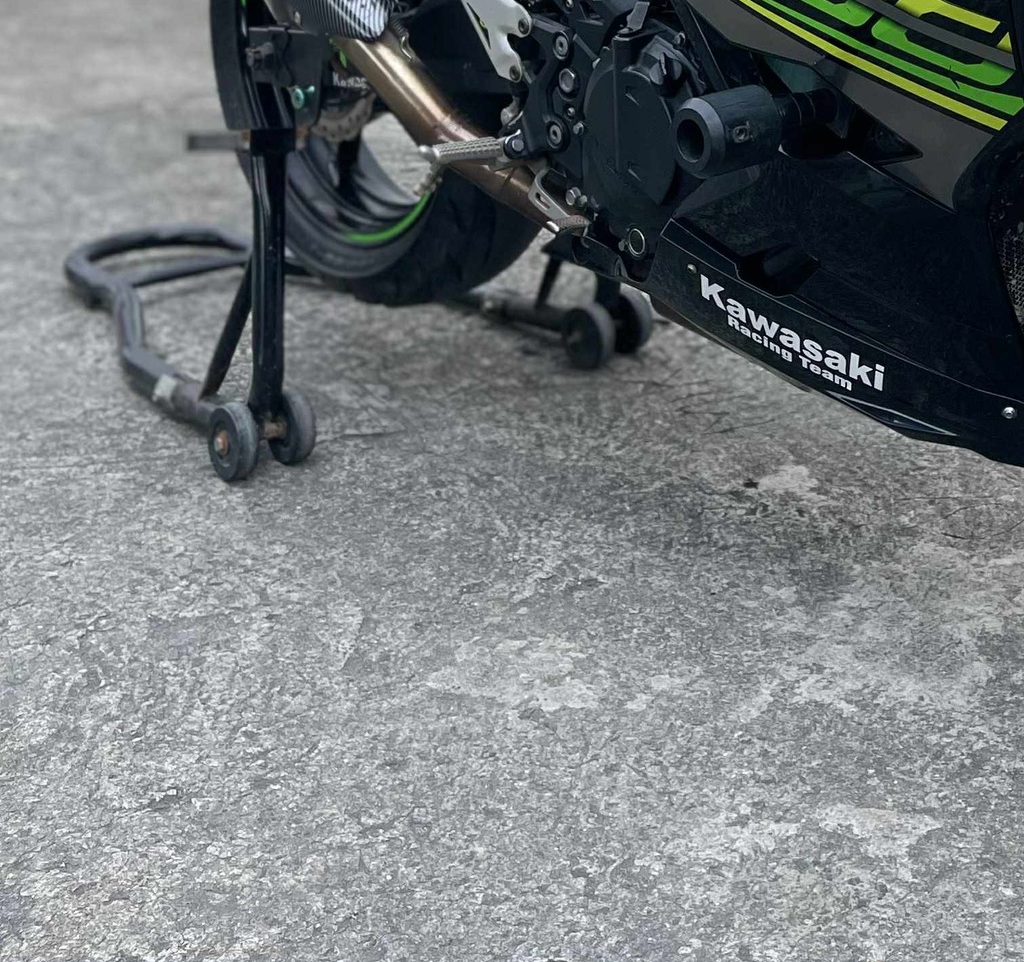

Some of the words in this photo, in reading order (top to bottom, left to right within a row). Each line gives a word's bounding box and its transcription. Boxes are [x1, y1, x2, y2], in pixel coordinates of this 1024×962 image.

[700, 273, 885, 392] Kawasaki
[727, 314, 793, 363] Racing
[798, 355, 853, 391] Team
